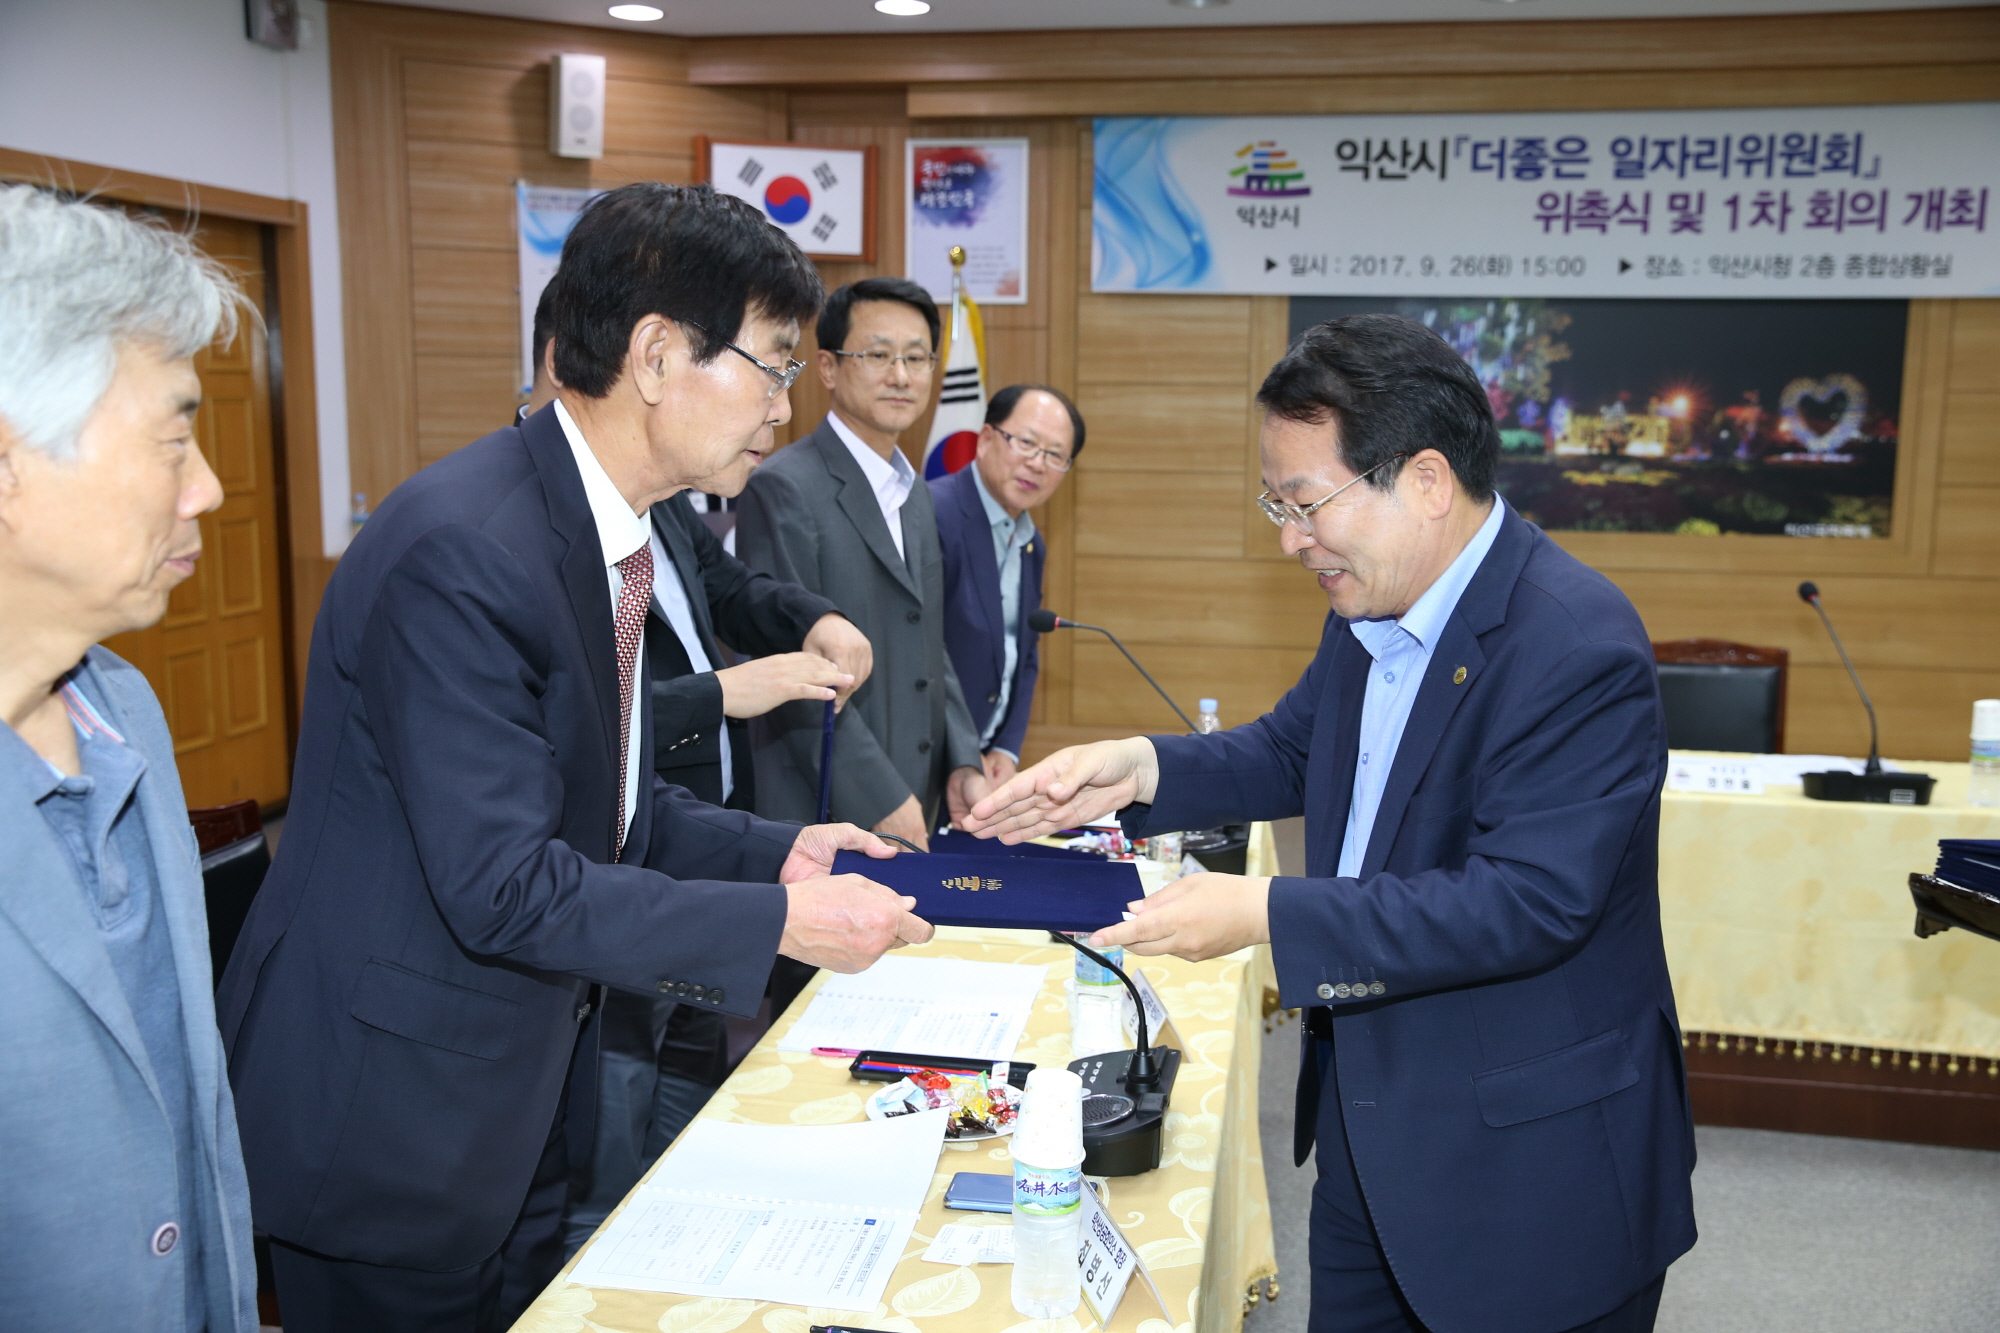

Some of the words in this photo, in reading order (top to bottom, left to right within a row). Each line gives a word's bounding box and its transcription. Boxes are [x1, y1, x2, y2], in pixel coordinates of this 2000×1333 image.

[1237, 206, 1299, 228] 익산시
[1534, 190, 1652, 234] 위촉식
[1666, 190, 1706, 234] 및
[1803, 188, 1889, 233] 회의
[1902, 187, 1989, 233] 개최
[1288, 254, 1327, 278] 일시
[1349, 255, 1412, 278] 2017.
[1419, 255, 1441, 278] 9.
[1450, 254, 1512, 279] 26(화)
[1522, 255, 1586, 278] 15:00
[1645, 254, 1685, 279] 장소
[1708, 254, 1792, 279] 익산시청
[1800, 254, 1835, 279] 2층
[1844, 253, 1953, 279] 종합상황실
[1113, 1247, 1128, 1269] 회장
